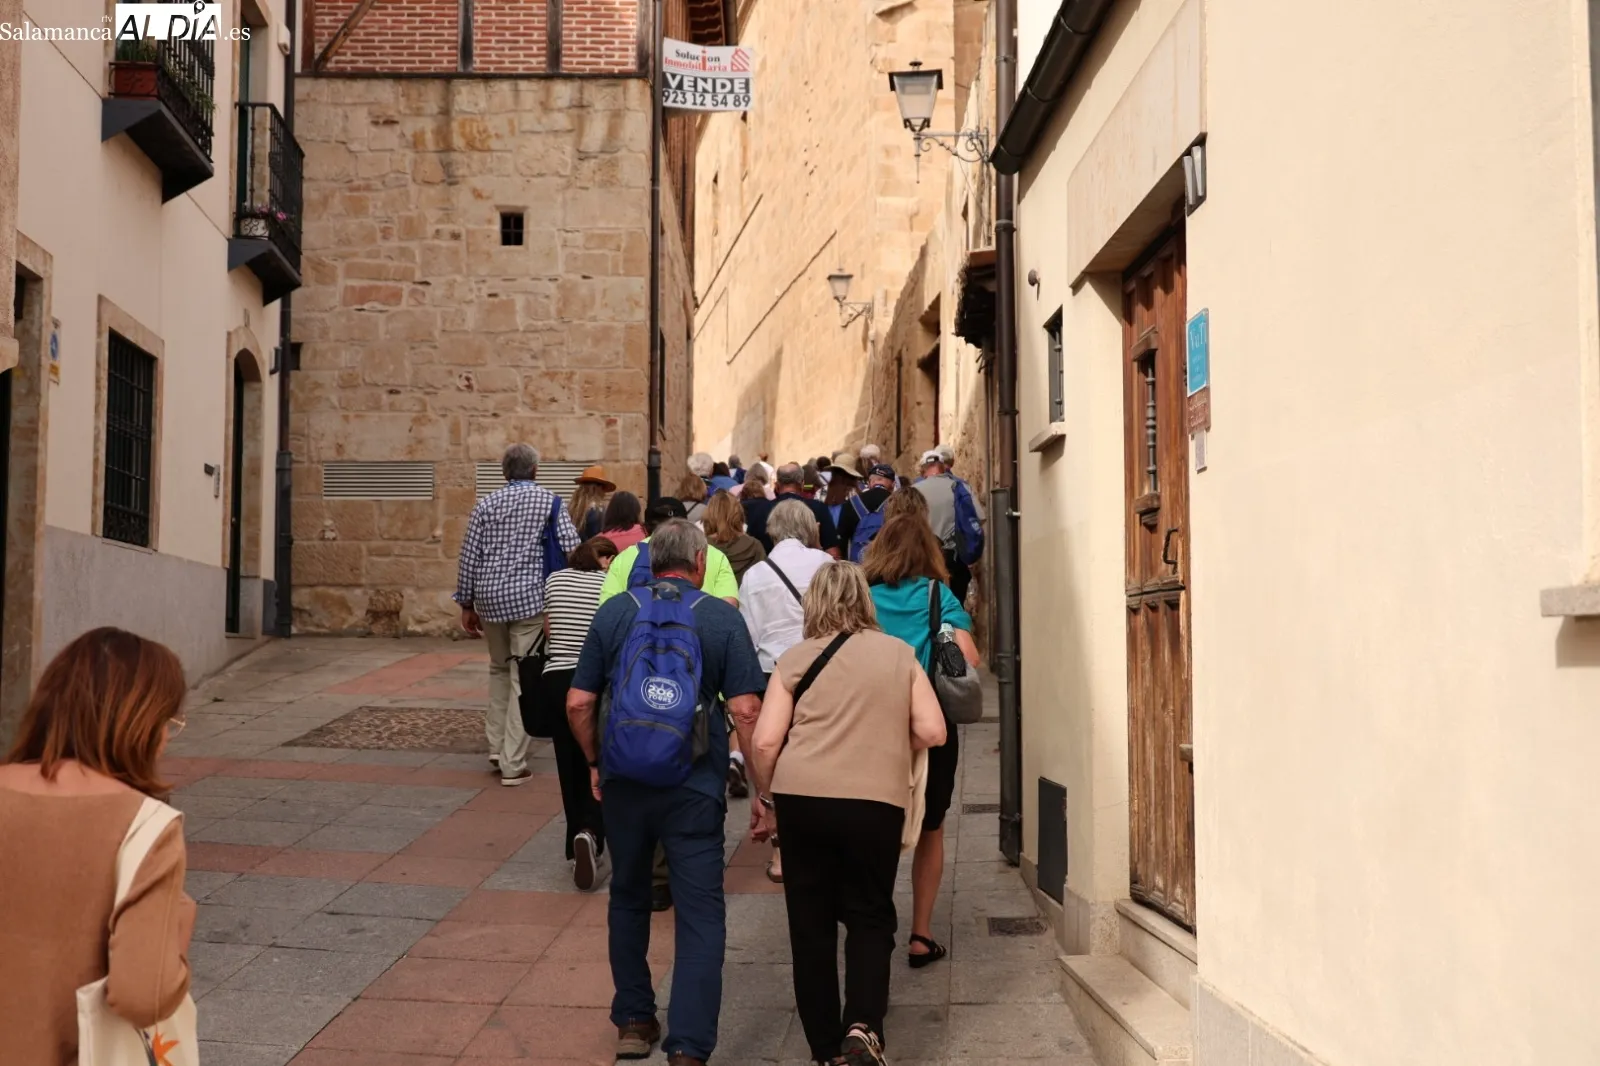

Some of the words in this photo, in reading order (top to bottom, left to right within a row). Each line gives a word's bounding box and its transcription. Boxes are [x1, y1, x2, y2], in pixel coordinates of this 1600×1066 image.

[665, 72, 746, 93] VENDE
[663, 89, 687, 105] 923
[691, 93, 706, 106] 12
[711, 94, 728, 107] 54
[733, 94, 751, 107] 89
